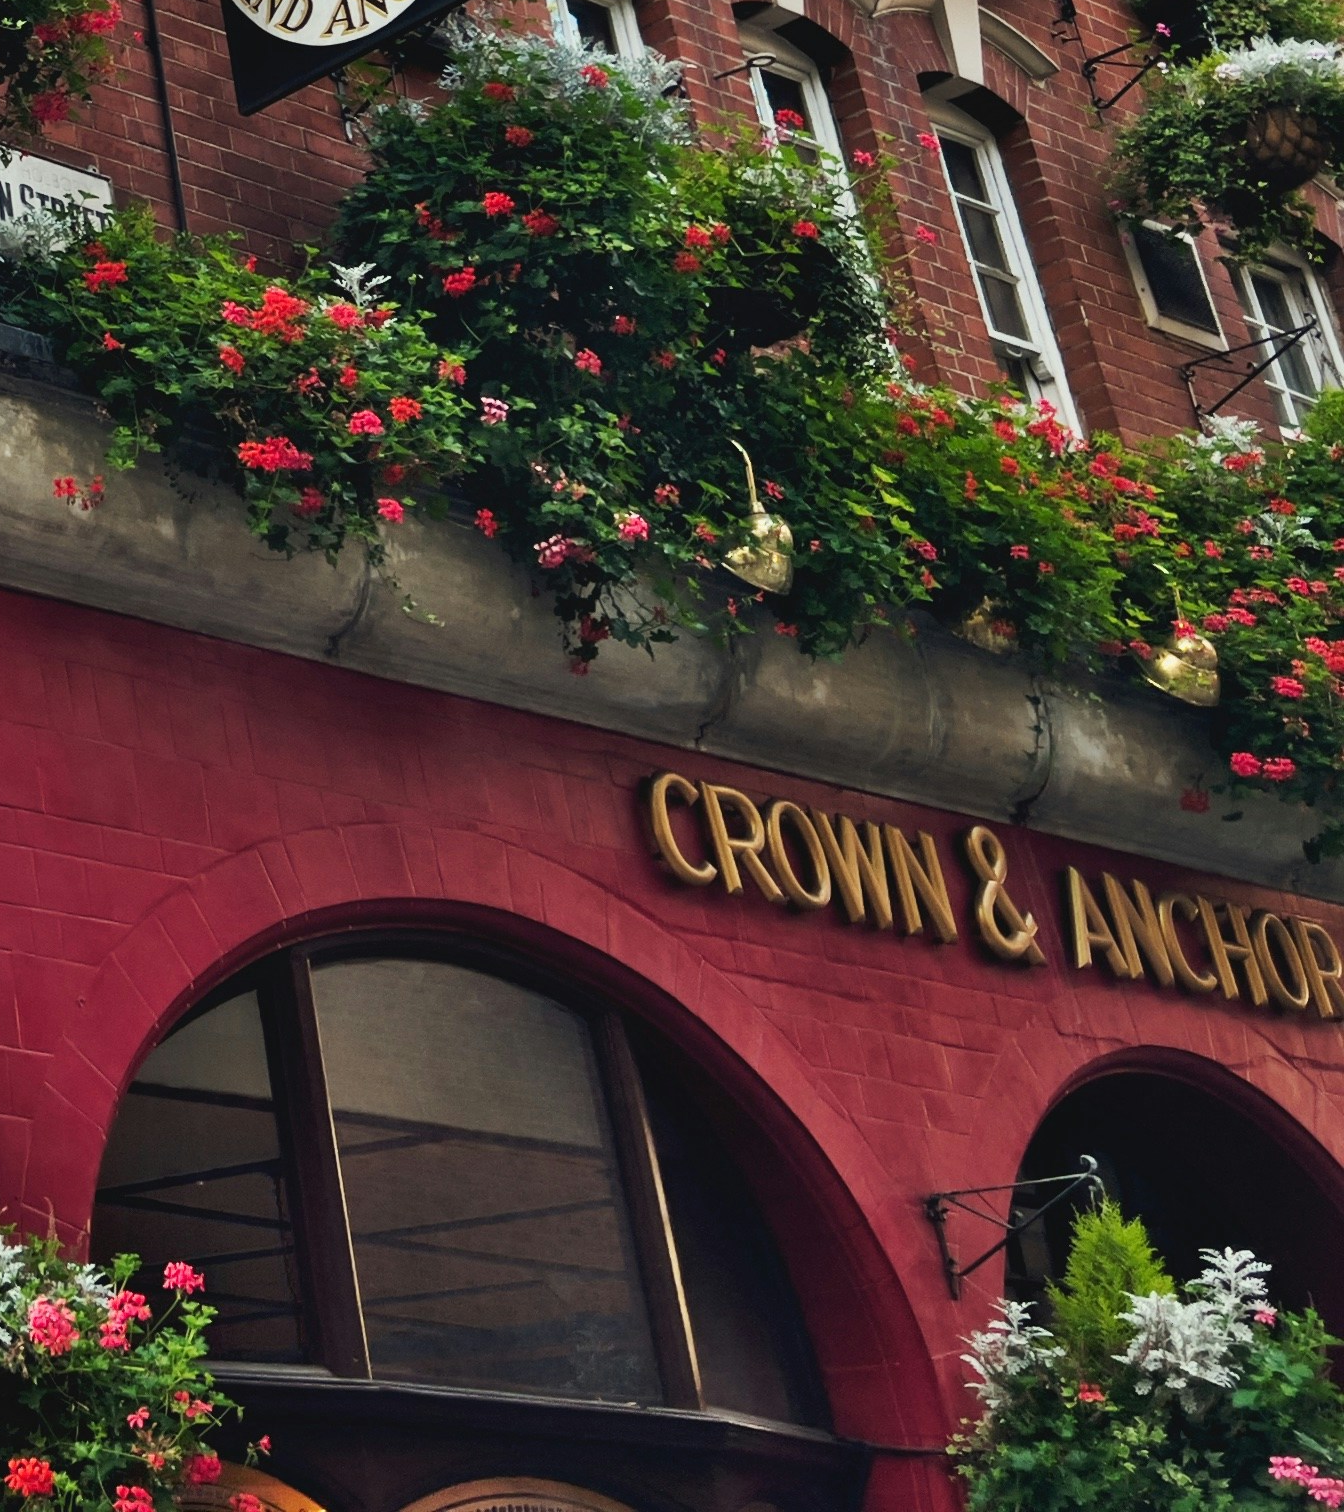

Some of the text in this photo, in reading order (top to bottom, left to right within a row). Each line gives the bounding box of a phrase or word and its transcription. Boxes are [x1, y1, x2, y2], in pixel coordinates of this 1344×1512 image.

[650, 772, 1344, 1020] CROWN & ANCHOR
